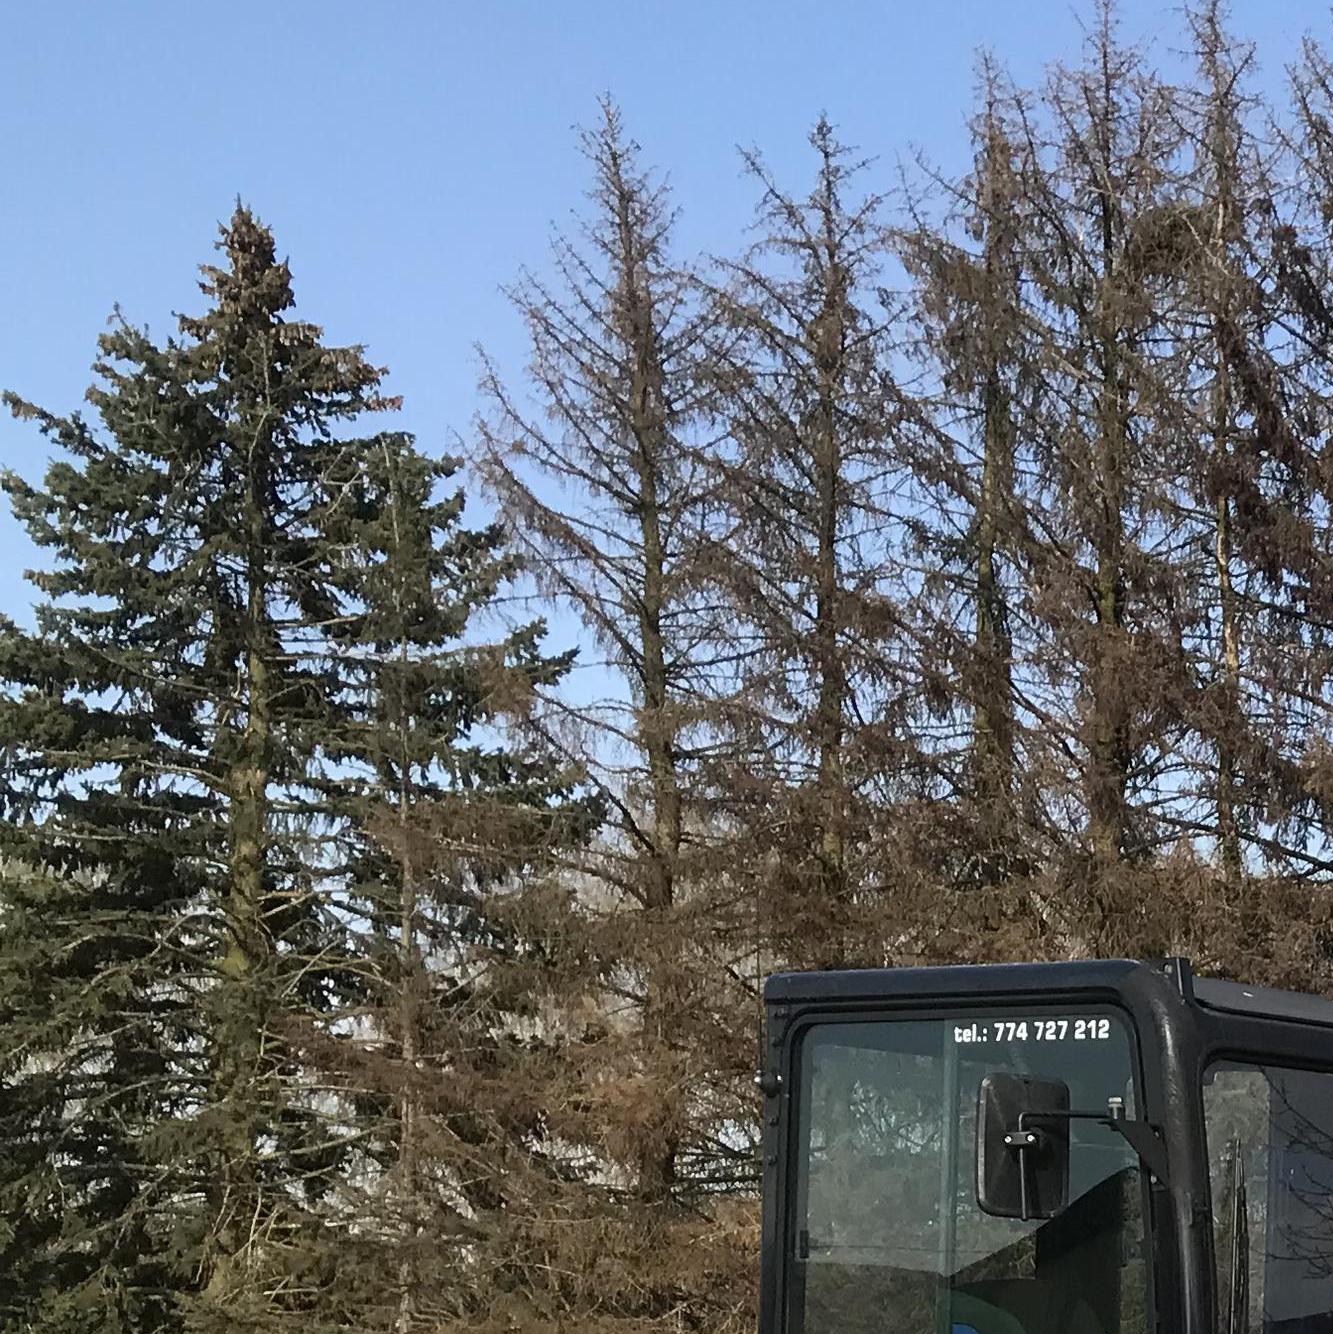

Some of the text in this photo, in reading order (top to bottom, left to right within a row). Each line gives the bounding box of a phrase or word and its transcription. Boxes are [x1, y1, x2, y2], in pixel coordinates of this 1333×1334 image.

[954, 1019, 1110, 1042] tel.: 774 727 212
